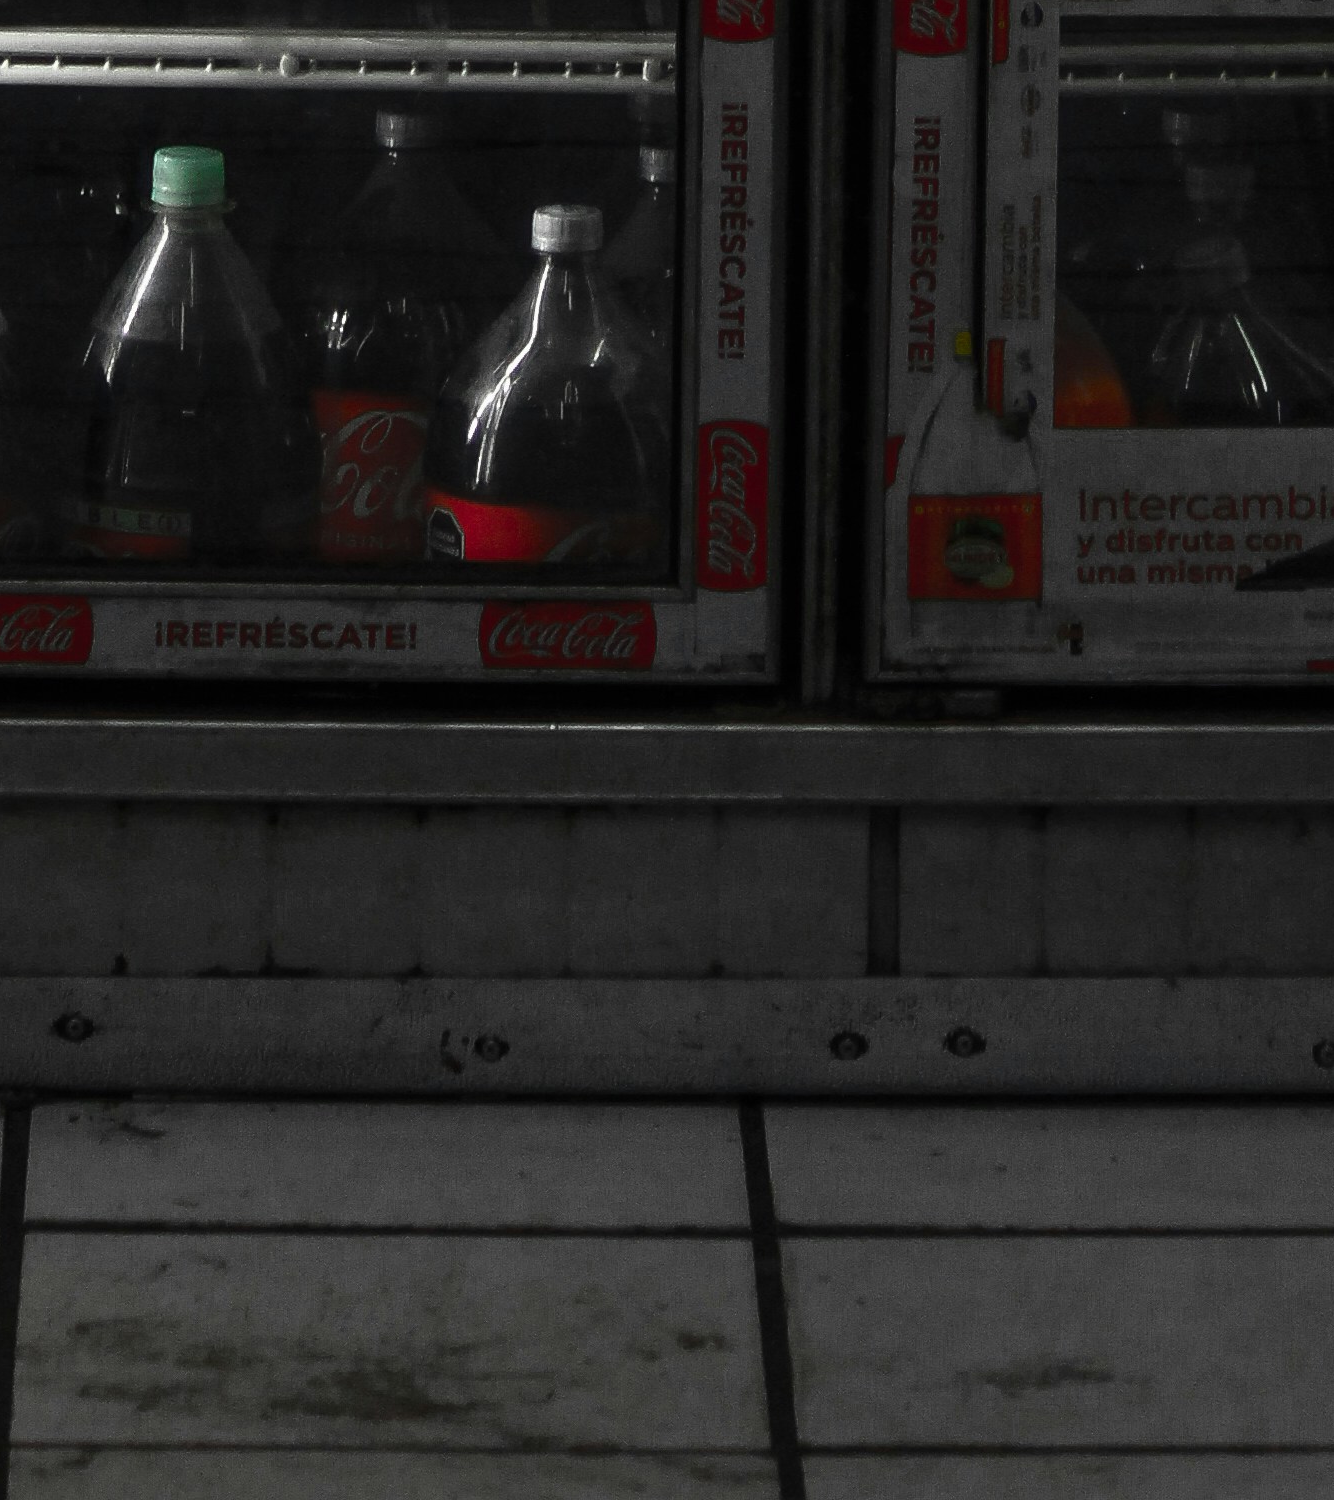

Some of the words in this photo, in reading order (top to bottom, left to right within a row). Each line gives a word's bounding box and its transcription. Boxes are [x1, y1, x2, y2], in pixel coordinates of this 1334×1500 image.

[1076, 532, 1096, 559] y
[1105, 528, 1236, 554] disfruta
[1244, 531, 1305, 553] con
[1076, 564, 1137, 585] una
